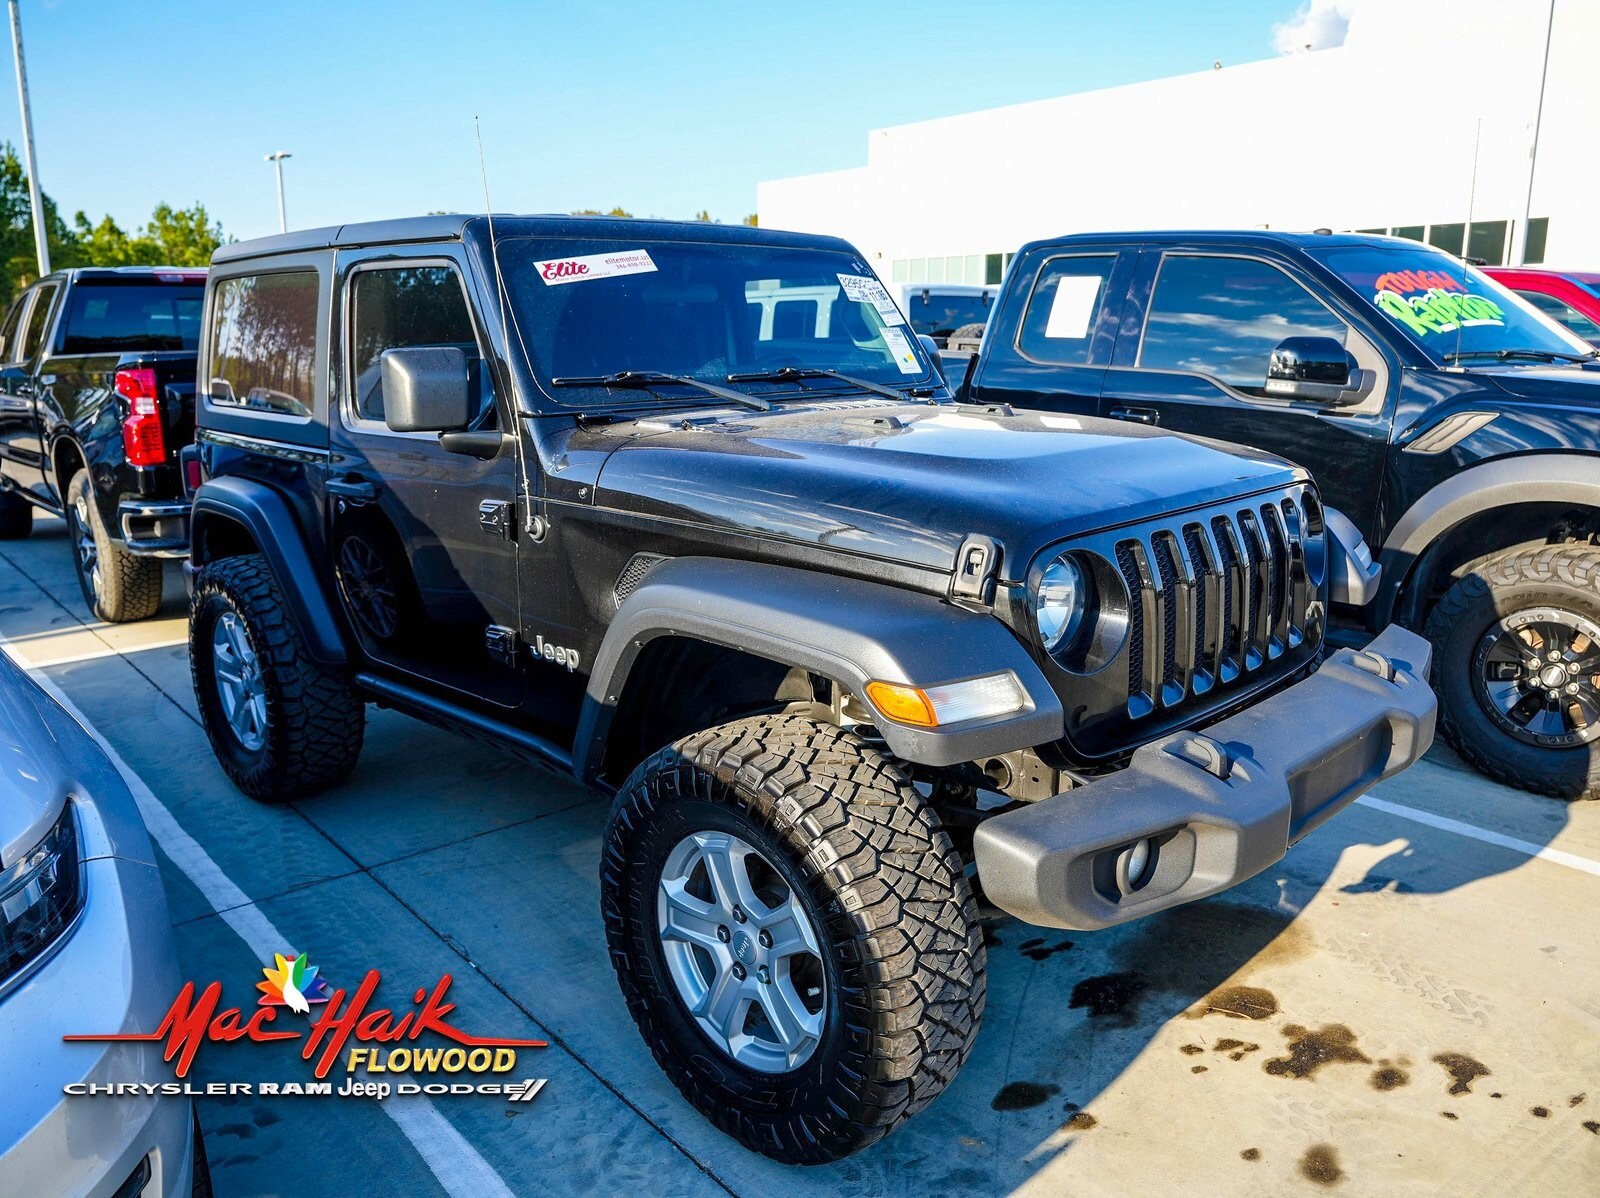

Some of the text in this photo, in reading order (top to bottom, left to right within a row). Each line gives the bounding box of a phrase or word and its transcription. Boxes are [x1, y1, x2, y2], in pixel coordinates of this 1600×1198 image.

[542, 261, 590, 280] Elite
[1375, 269, 1469, 295] TOUGH
[529, 634, 580, 673] Jeep
